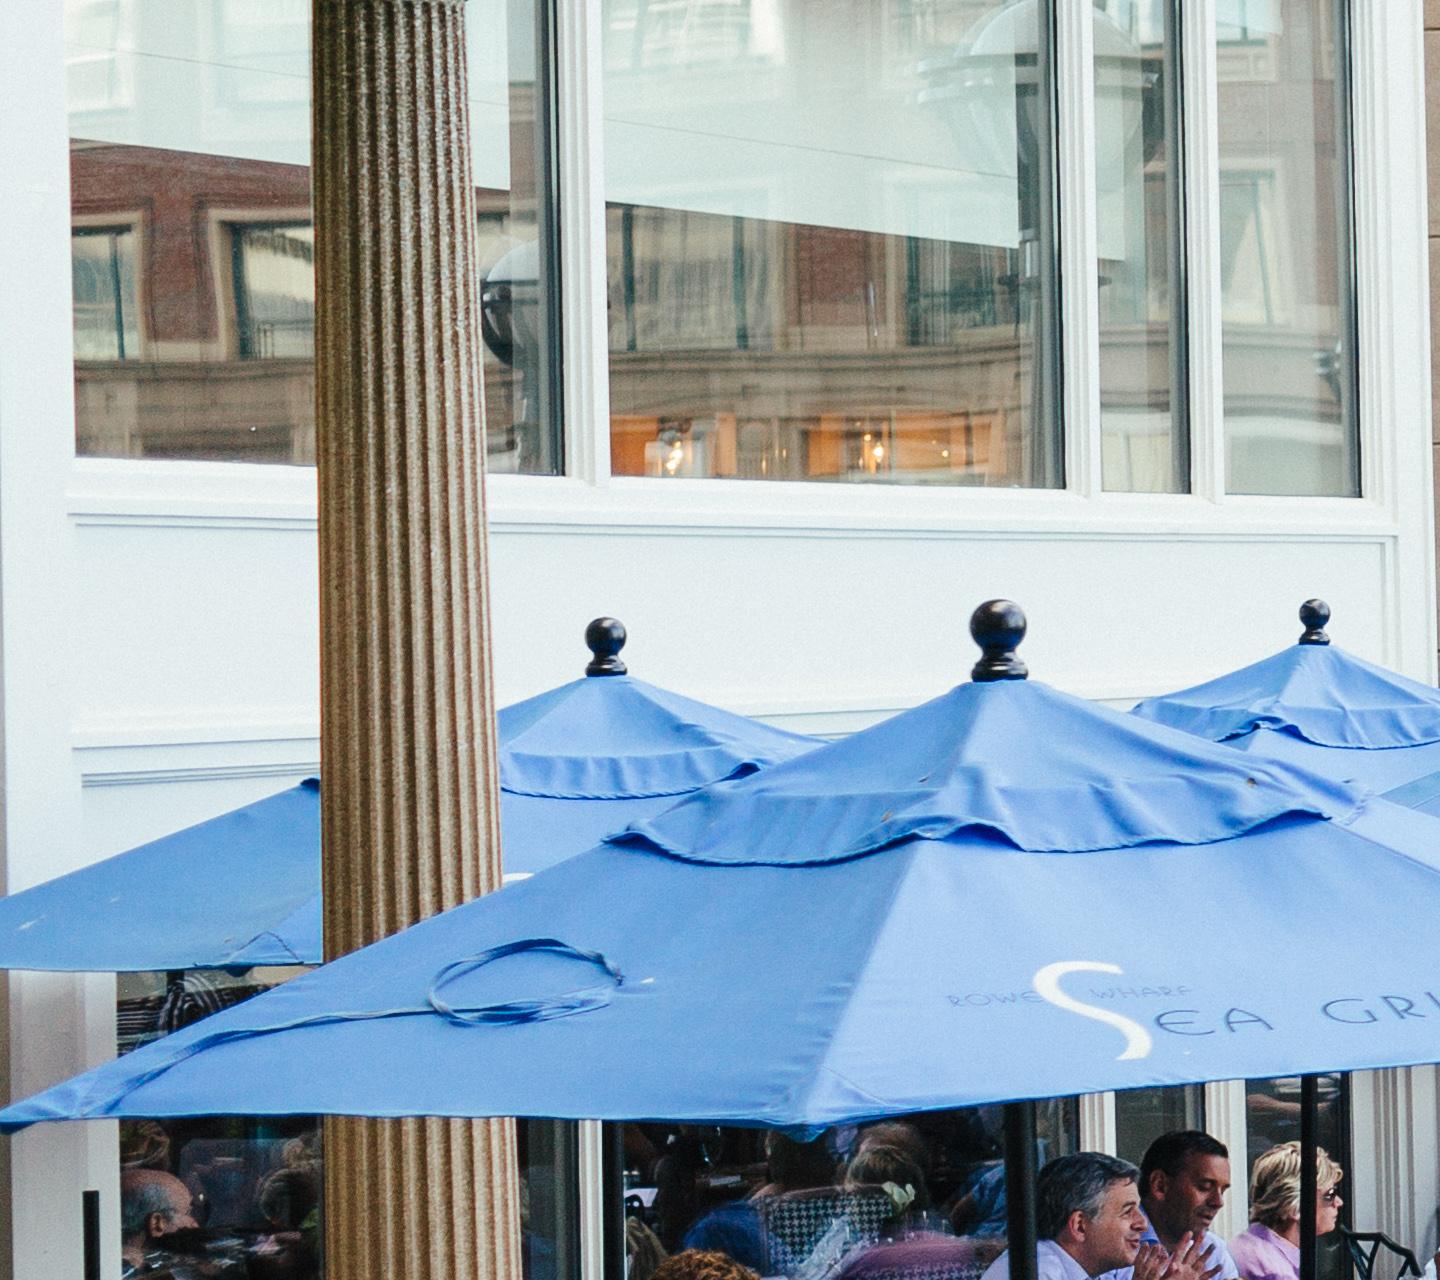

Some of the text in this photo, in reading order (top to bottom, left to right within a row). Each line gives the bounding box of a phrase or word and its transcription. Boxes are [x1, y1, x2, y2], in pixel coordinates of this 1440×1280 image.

[946, 983, 1194, 1008] ROWE WHARF
[1032, 960, 1275, 1061] SEA
